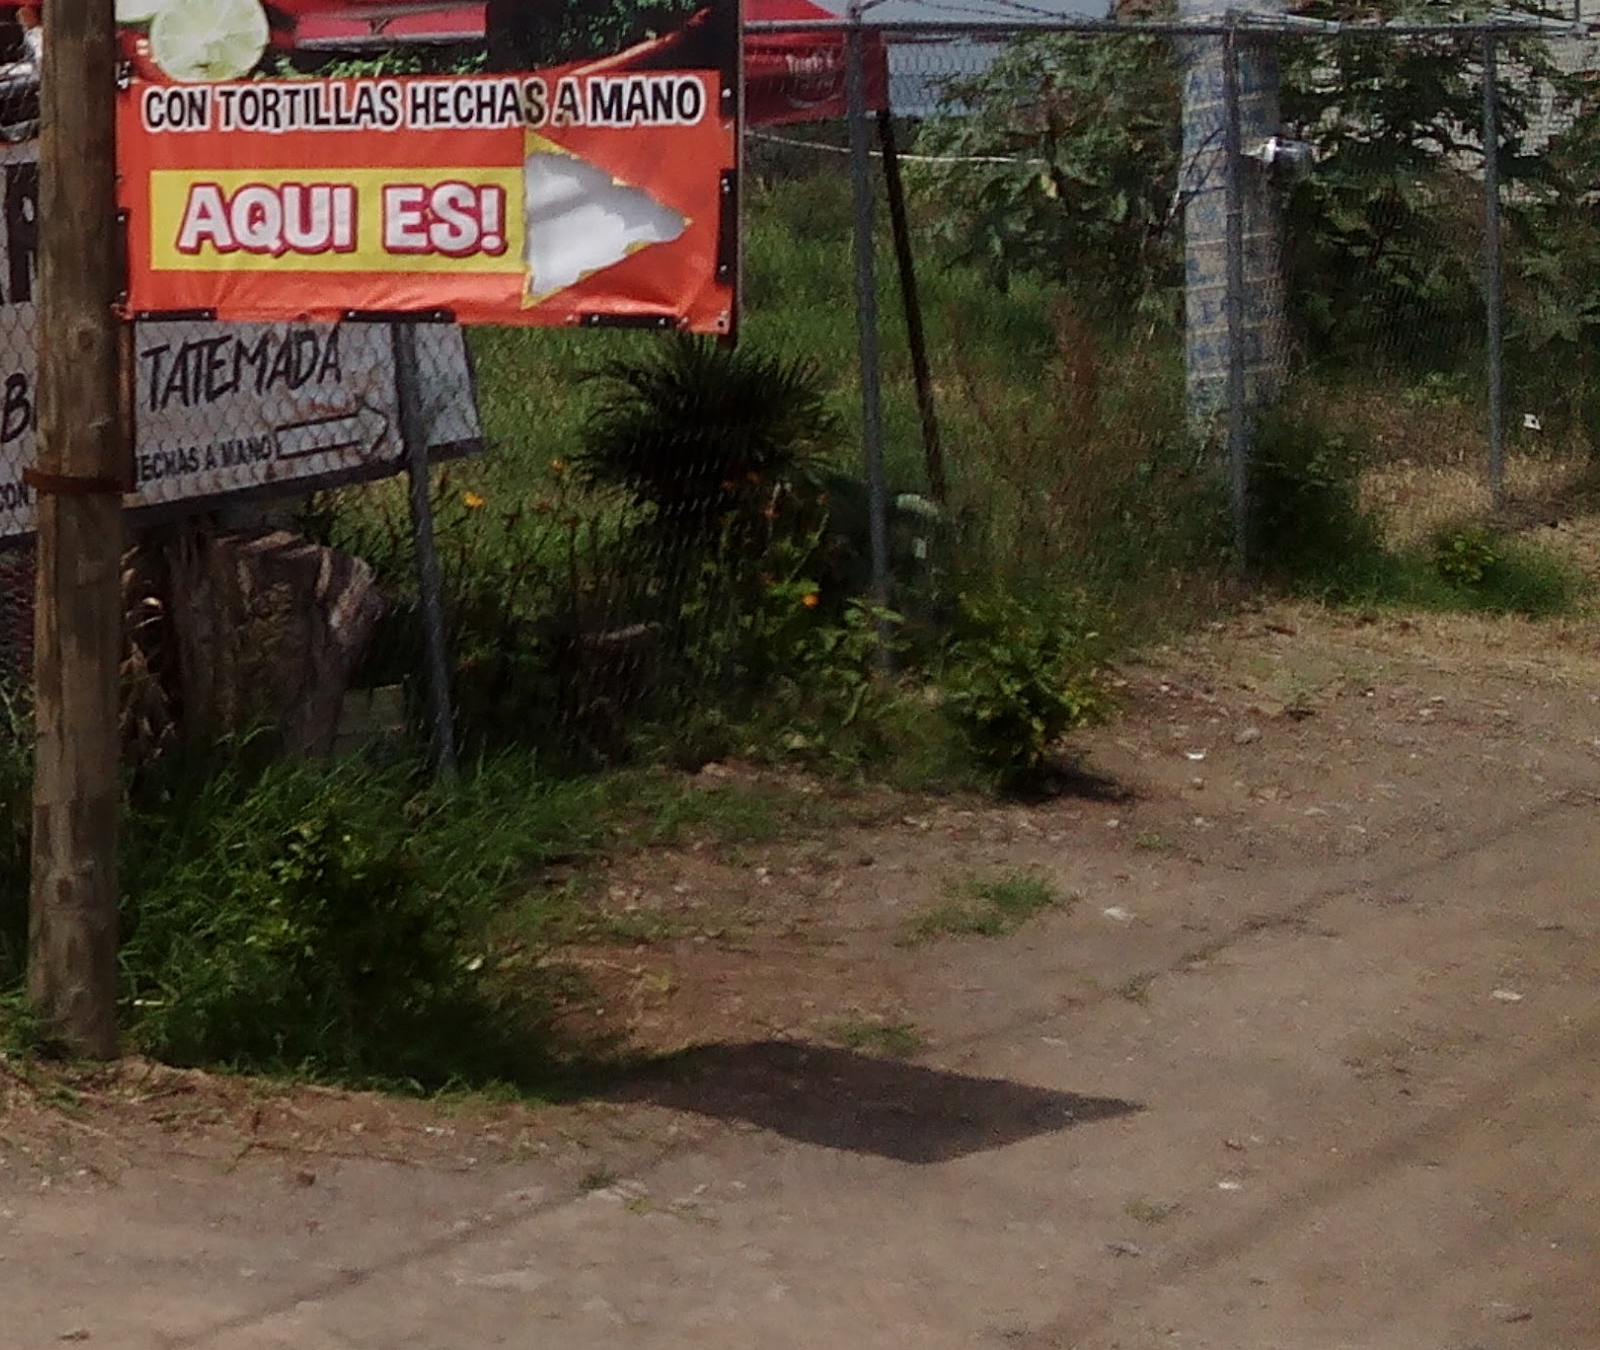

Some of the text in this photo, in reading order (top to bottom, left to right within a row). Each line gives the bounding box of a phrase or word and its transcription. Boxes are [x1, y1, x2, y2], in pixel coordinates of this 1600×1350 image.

[145, 78, 704, 129] CON TORTILLAS HECHAS A MANO
[178, 182, 507, 257] AQUI ES!
[141, 325, 342, 411] TATEMADA
[138, 446, 200, 482] ECHAS
